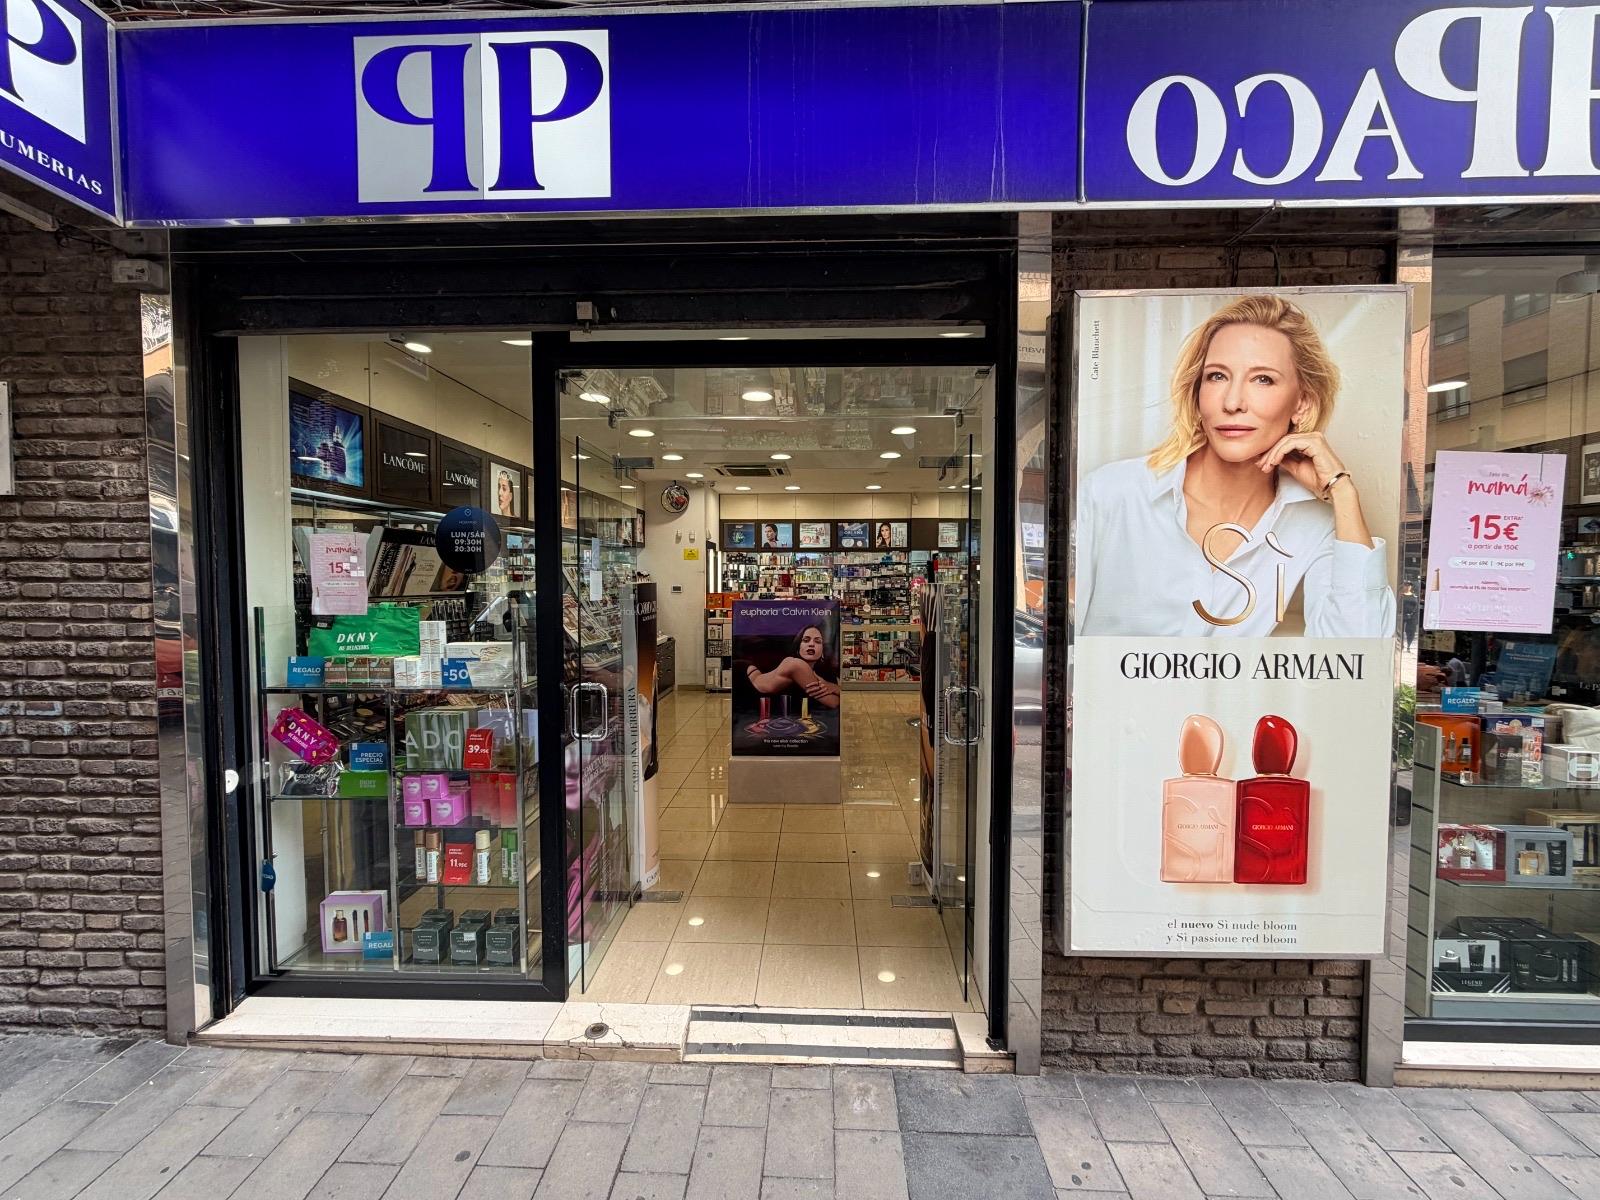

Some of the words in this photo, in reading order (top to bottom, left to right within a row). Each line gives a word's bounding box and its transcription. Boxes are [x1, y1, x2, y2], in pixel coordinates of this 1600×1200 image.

[1092, 320, 1100, 359] Blanchett
[1091, 361, 1099, 380] Cate
[383, 452, 426, 475] LANCÔME
[445, 470, 479, 489] LANCÔME
[1467, 473, 1528, 497] mamá
[450, 530, 486, 540] LUN/SÁB
[740, 607, 779, 618] euphoria
[782, 607, 810, 616] Calvin
[811, 607, 832, 616] Klein
[336, 631, 378, 644] DKNY
[1120, 652, 1241, 680] GIORGIO
[1251, 653, 1364, 680] ARMANI
[1447, 697, 1475, 705] REGALO
[627, 686, 639, 738] HERRERA
[287, 721, 318, 746] DKNY
[630, 740, 640, 793] CAROLINA
[1167, 918, 1177, 929] el
[1181, 921, 1214, 929] nuevo
[1232, 920, 1260, 930] nude
[1263, 920, 1297, 931] bloom
[1165, 935, 1172, 945] y
[1191, 933, 1238, 945] passione
[1241, 933, 1259, 943] red
[1263, 934, 1297, 944] bloom
